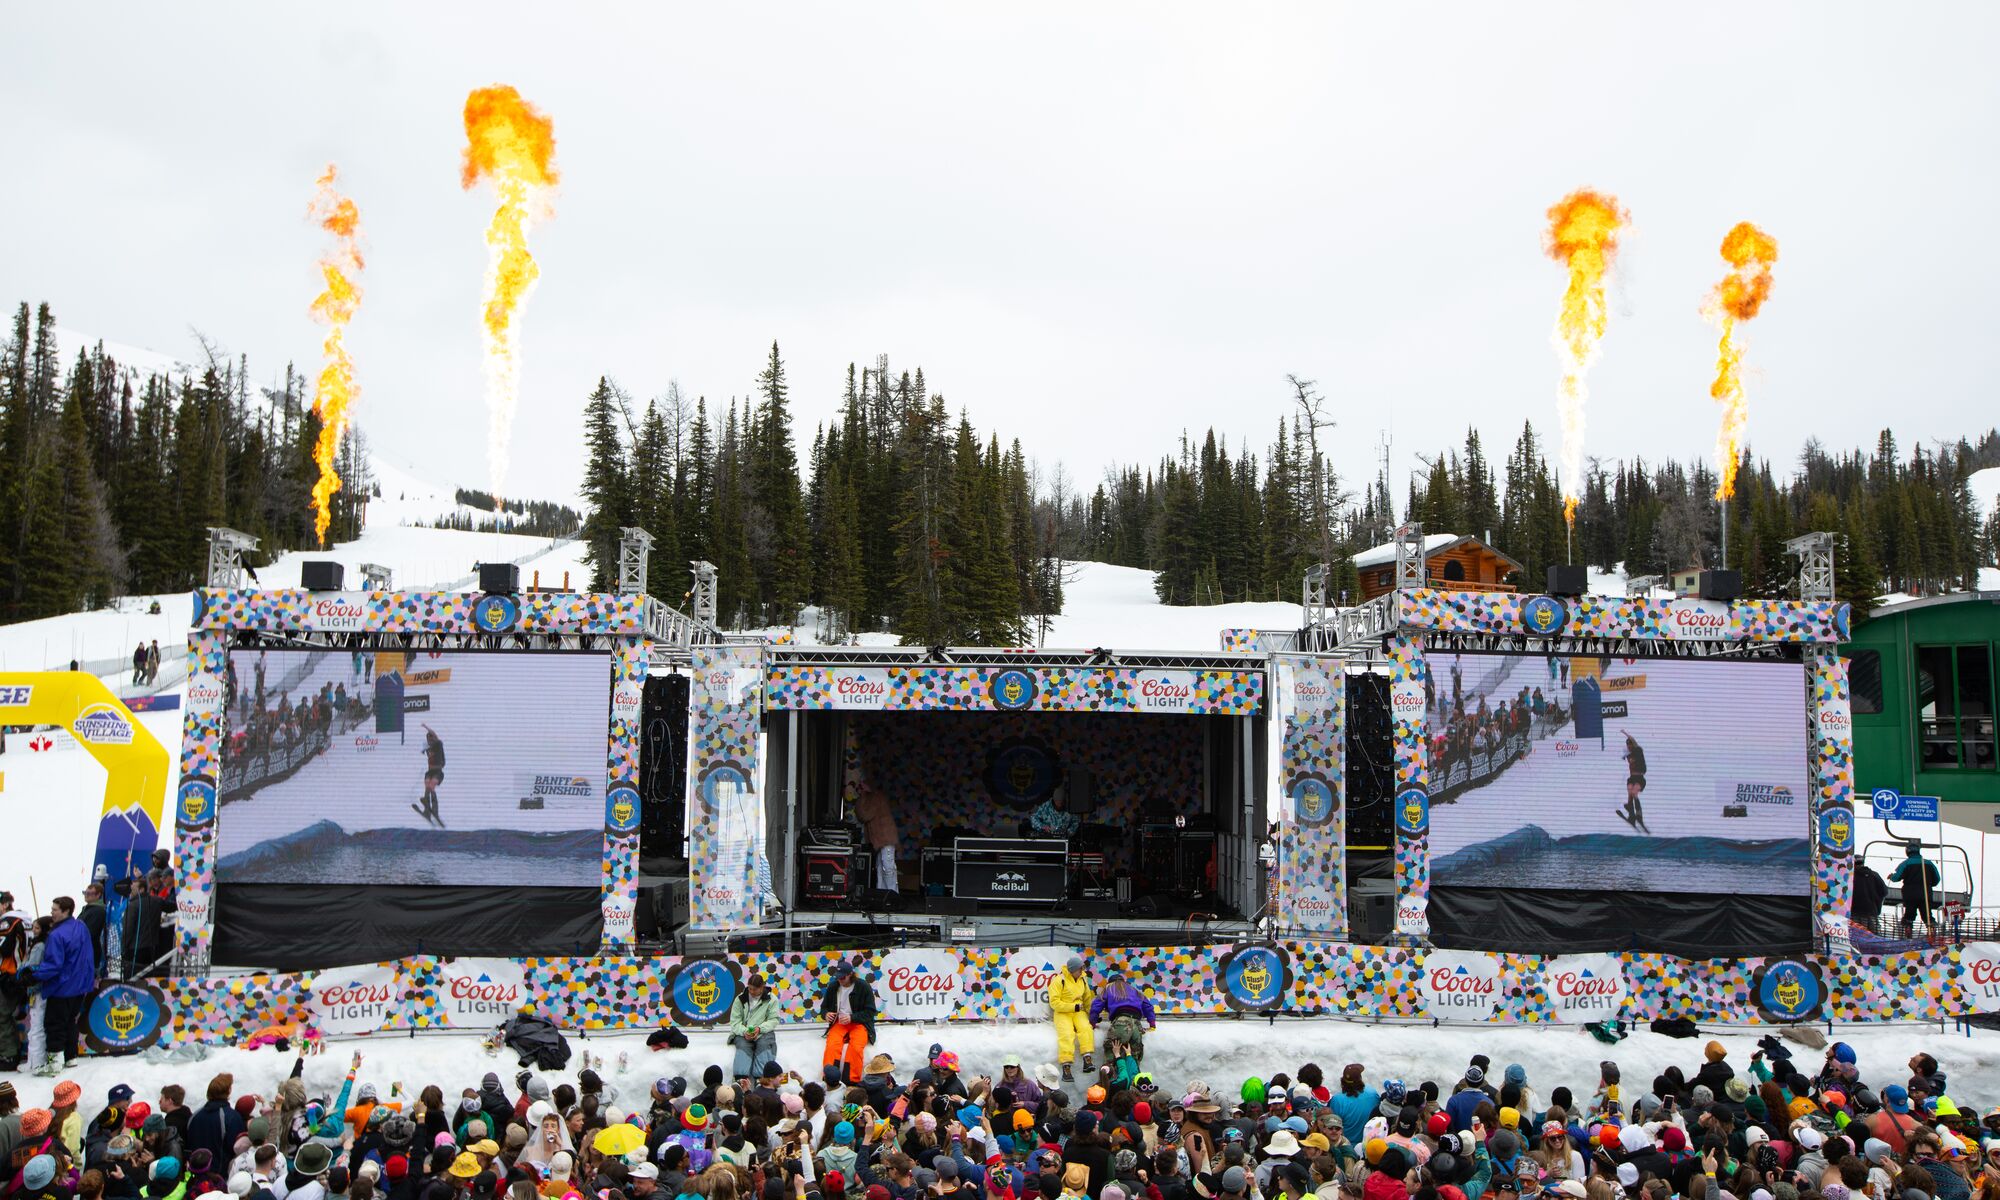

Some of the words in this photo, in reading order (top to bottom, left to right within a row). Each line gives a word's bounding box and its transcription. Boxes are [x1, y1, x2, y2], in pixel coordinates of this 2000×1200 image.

[316, 600, 363, 617] Coors
[320, 618, 358, 627] LIGHT
[1675, 609, 1725, 626] Coors
[1682, 627, 1720, 636] LIGHT
[413, 671, 440, 682] IKON
[1609, 676, 1635, 688] IKON
[837, 677, 884, 695] Coors
[1142, 679, 1189, 697] Coors
[1294, 683, 1327, 694] Coors
[188, 688, 218, 698] Coors
[1393, 693, 1424, 705] Coors
[843, 695, 879, 704] LIGHT
[1147, 698, 1185, 707] LIGHT
[1820, 711, 1850, 724] Coor
[75, 719, 131, 731] SUNSHINE
[83, 728, 132, 739] VILLAGE
[534, 776, 572, 786] BANFF
[533, 785, 592, 797] SUNSHINE
[1737, 783, 1774, 794] BANFF
[1736, 793, 1794, 805] SUNSHINE
[991, 883, 1010, 891] Red
[1011, 883, 1029, 891] Bull
[178, 900, 207, 913] Coors
[1298, 897, 1330, 910] Coors
[603, 906, 631, 919] Coors
[1399, 907, 1425, 919] Coor
[888, 967, 955, 991] Coors
[1246, 975, 1265, 983] Slush
[1430, 967, 1495, 993] Coors
[1554, 972, 1620, 996] Coors
[450, 976, 518, 1001] Coors
[694, 989, 713, 997] Slush
[1248, 983, 1262, 991] Cup
[319, 984, 390, 1006] Coors
[696, 997, 710, 1005] Cup
[896, 992, 948, 1005] LIGHT
[1024, 991, 1049, 1004] LIG
[1438, 993, 1487, 1007] LIGHT
[458, 1000, 510, 1014] LIGHT
[1564, 996, 1613, 1009] LIGHT
[1782, 997, 1796, 1006] Cup
[331, 1003, 384, 1020] LIGHT
[115, 1022, 132, 1030] Cup
